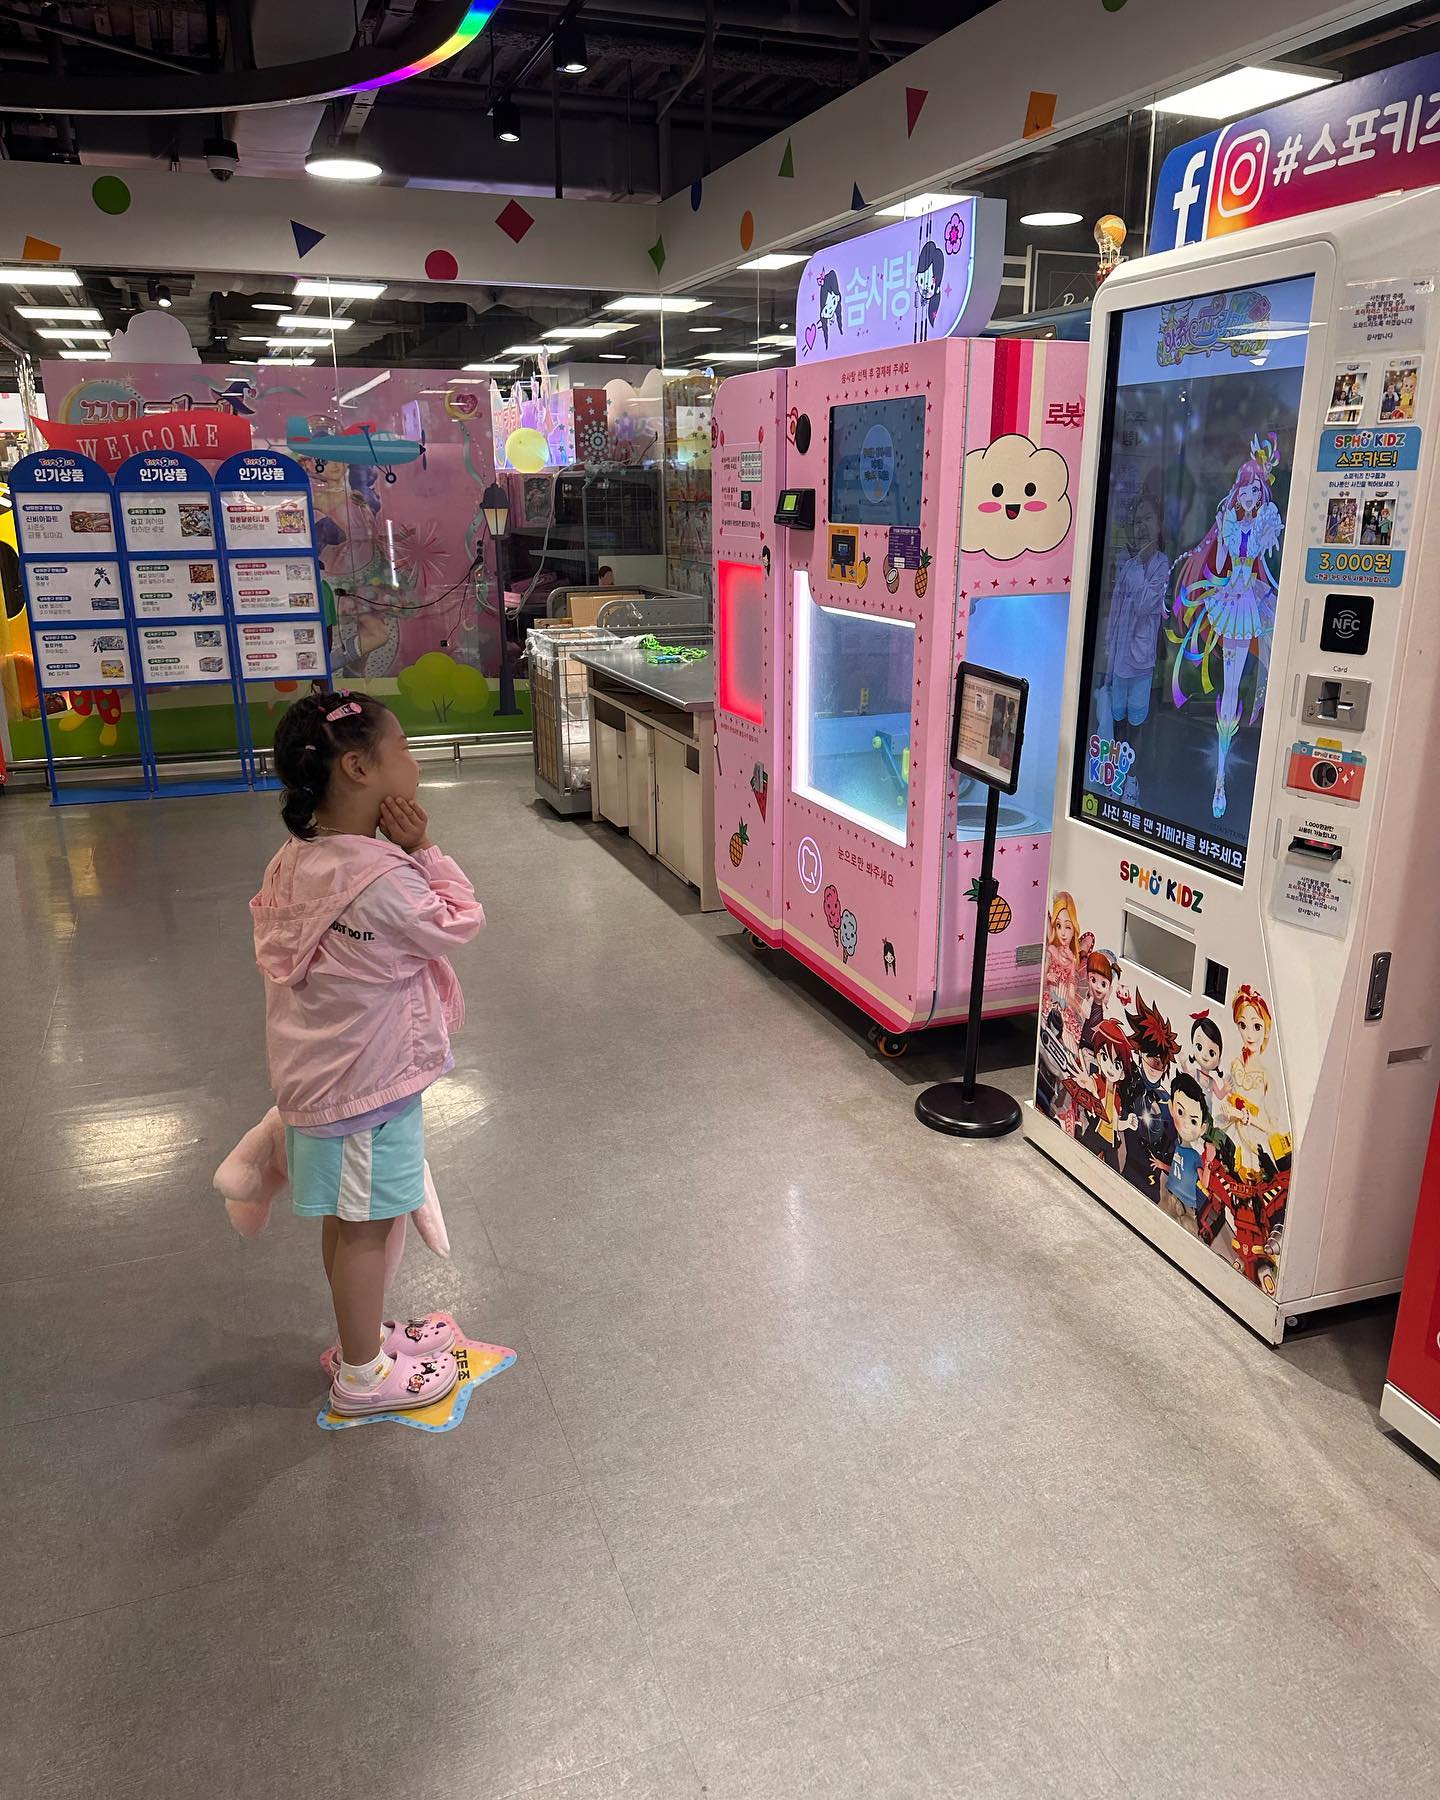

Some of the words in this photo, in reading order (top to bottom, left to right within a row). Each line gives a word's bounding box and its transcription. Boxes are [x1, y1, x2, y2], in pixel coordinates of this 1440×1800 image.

[844, 250, 916, 329] 솜사탕
[1367, 332, 1393, 341] 감사합니다
[892, 362, 910, 376] 주세요
[1046, 402, 1085, 428] 로봇
[77, 423, 218, 461] WELCOME
[1374, 432, 1406, 448] KIDZ
[1335, 450, 1397, 468] 스포카드!
[34, 468, 84, 482] 인기상품
[139, 468, 188, 482] 인기상품
[238, 468, 285, 482] 인기상품
[1318, 552, 1392, 574] 3,000원
[1332, 617, 1360, 632] NFC
[1333, 665, 1348, 674] Card
[1089, 758, 1128, 796] KIDZ
[1102, 802, 1120, 822] 사진
[1122, 810, 1141, 830] 찍을
[1143, 817, 1154, 835] 땐
[1156, 822, 1196, 851] 카메라를
[1298, 826, 1313, 835] 사용이
[1313, 829, 1338, 840] 가능합니다
[838, 845, 864, 872] 눈으로만
[866, 861, 894, 888] 봐주세요
[1166, 878, 1205, 914] KIDZ
[332, 921, 346, 934] UST
[348, 928, 361, 940] DO
[364, 932, 375, 941] IT.
